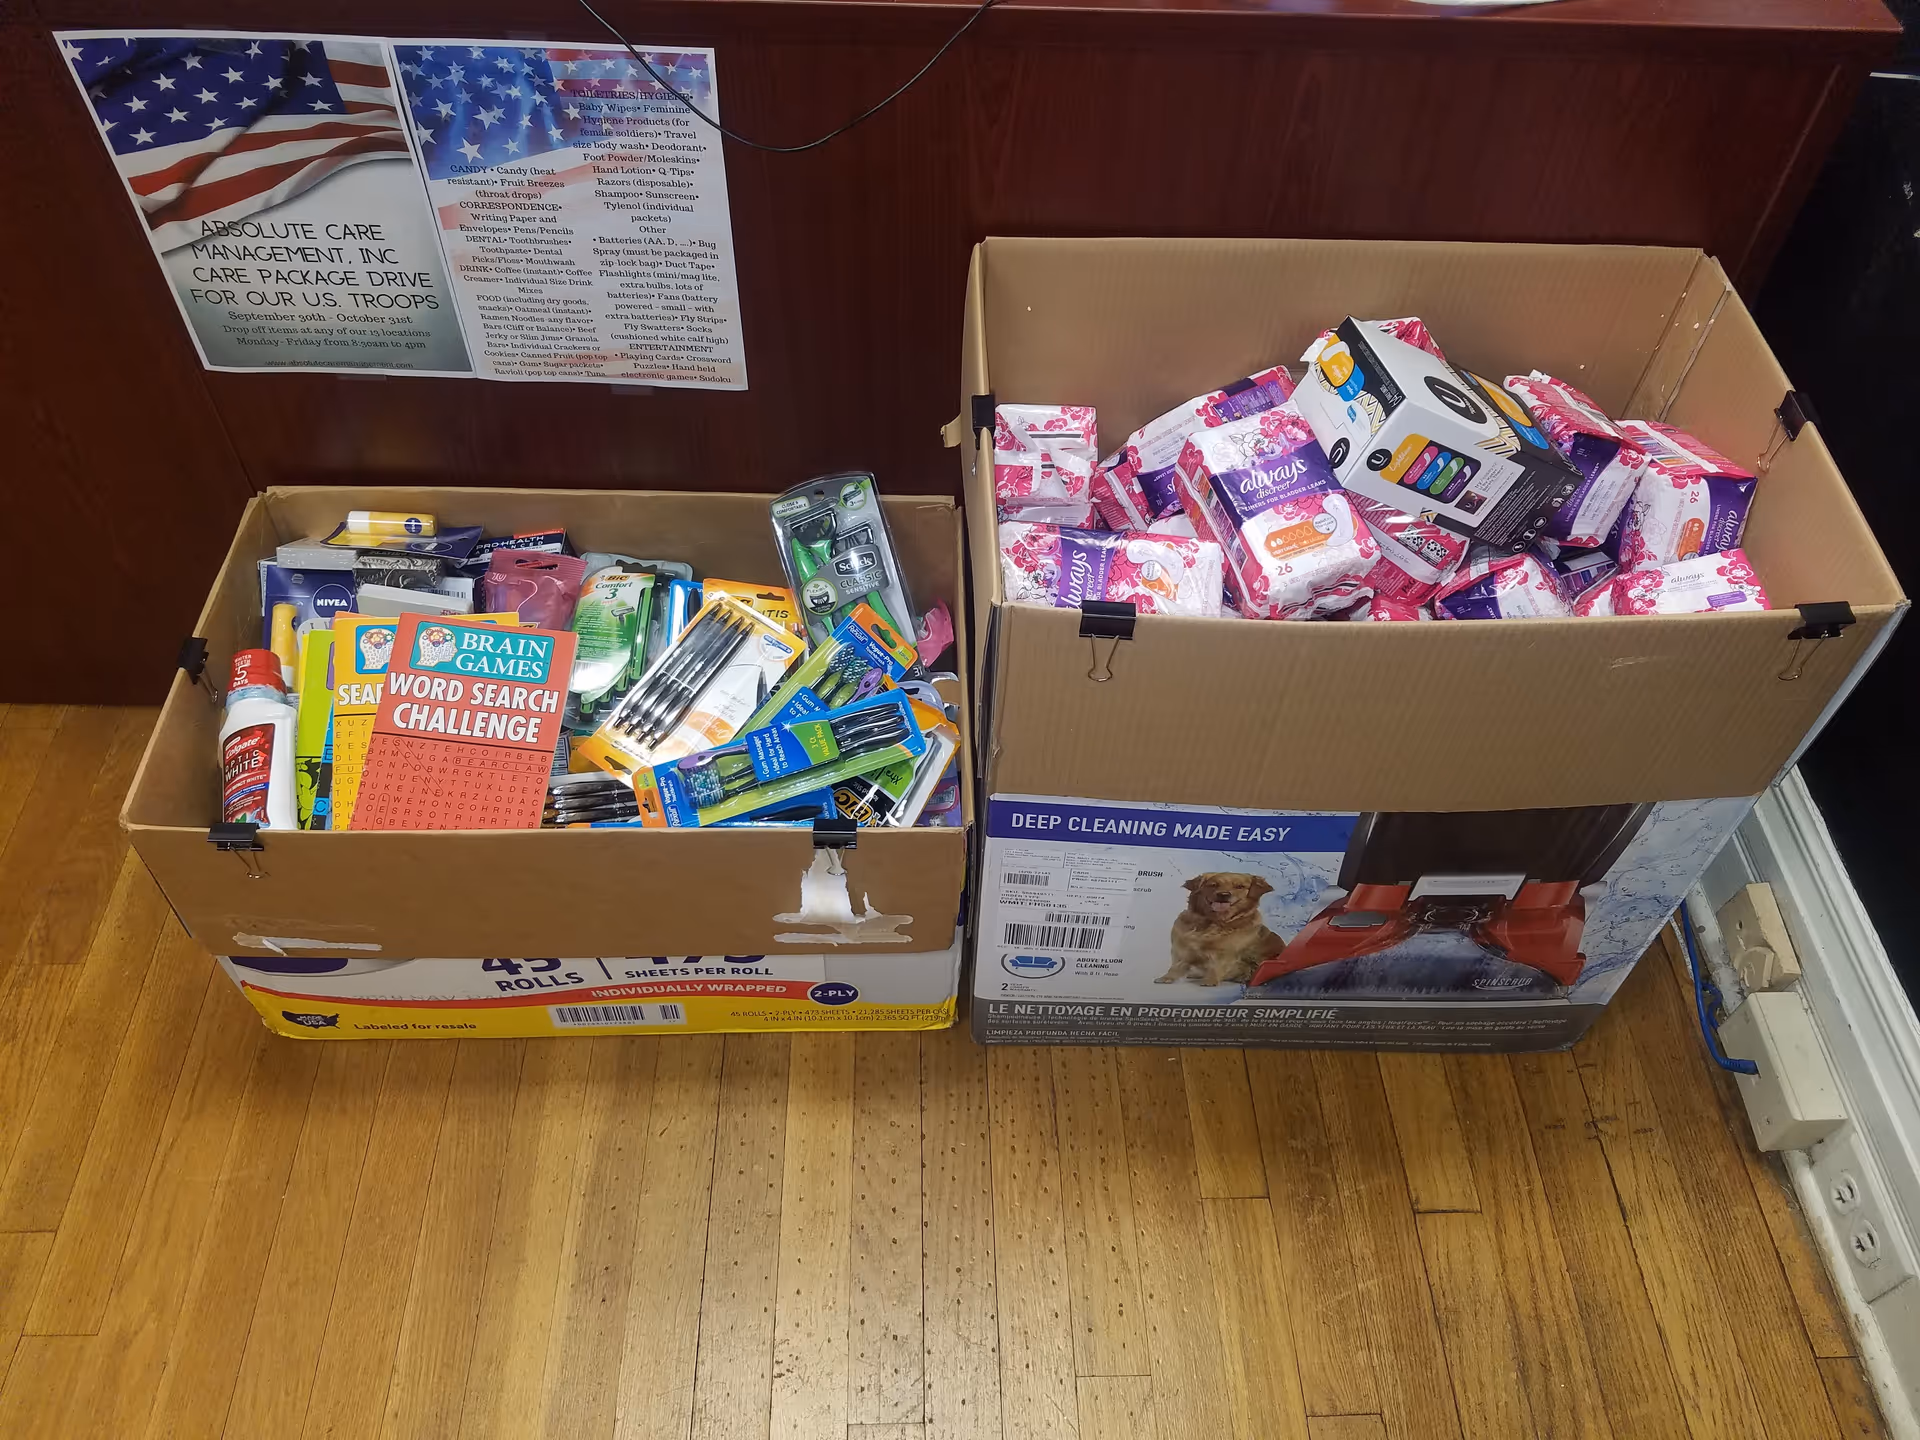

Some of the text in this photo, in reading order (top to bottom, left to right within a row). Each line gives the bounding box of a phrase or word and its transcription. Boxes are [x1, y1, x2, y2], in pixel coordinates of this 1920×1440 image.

[583, 116, 670, 126] Hygiene Products
[580, 128, 696, 139] female Travel
[594, 142, 617, 150] body
[450, 165, 556, 176] CANDY Candy (heat
[501, 179, 564, 188] Fruit Breezes
[597, 178, 630, 186] Razors
[475, 190, 542, 200] (throat drops)
[604, 202, 694, 212] Tylenol (individual
[470, 213, 507, 223] Writing
[509, 215, 536, 223] Paper
[631, 215, 672, 223] packets)
[201, 220, 385, 241] ABSOLUTE CARE
[514, 226, 574, 235] Pens/Pencils
[698, 240, 716, 249] Bug
[362, 248, 399, 264] INC
[593, 248, 708, 259] Spray packaged
[193, 267, 433, 287] CARE PACKAGE DRIVE
[495, 267, 522, 275] Coffee
[599, 270, 700, 281] Flashlights (mini/mag
[505, 275, 548, 285] Individual
[190, 289, 439, 309] FOR OUR U.S. TROOPS
[503, 295, 545, 304] (including
[228, 311, 412, 324] September 30th October 31st
[223, 325, 250, 335] Drop
[252, 325, 267, 334] off
[268, 327, 298, 335] items
[314, 329, 334, 337] any
[369, 330, 379, 338] 13
[381, 329, 430, 337] locations
[286, 337, 322, 348] Friday
[323, 338, 349, 347] from
[351, 339, 388, 348] 8:30am
[391, 340, 401, 348] to
[404, 341, 426, 349] 4pm
[629, 344, 713, 352] ENTERTAINMENT
[1240, 459, 1308, 494] always
[1246, 501, 1266, 511] LINERS
[1280, 488, 1307, 499] BLADDER
[1308, 479, 1326, 489] LEAKS
[1256, 481, 1291, 499] discreet
[1690, 491, 1699, 503] 26
[1278, 563, 1292, 575] 26
[840, 571, 881, 588] CLASSIC
[1097, 565, 1105, 591] BLADDER
[1671, 572, 1704, 584] always
[605, 589, 618, 599] 3
[846, 582, 879, 594] SENSITIVE
[460, 632, 548, 658] BRAIN
[869, 642, 894, 666] Vogue-Pro
[455, 653, 544, 679] GAMES
[235, 665, 247, 681] 5
[233, 679, 248, 687] DAYS
[389, 672, 559, 713] WORD SEARCH
[801, 694, 814, 707] Gum
[794, 702, 808, 715] Ideal
[393, 702, 541, 743] CHALLENGE
[763, 733, 772, 747] Hard
[771, 728, 780, 743] Areas
[814, 724, 830, 756] VALUE PACK
[226, 736, 260, 760] Colgate
[776, 743, 786, 761] Reach
[225, 750, 260, 772] OPTIC
[753, 736, 769, 775] Gum Massager
[225, 759, 262, 782] WHITE
[771, 757, 780, 771] Ideal
[886, 769, 903, 785] Xtra
[660, 776, 670, 804] Vogue-Pro
[1012, 813, 1290, 842] DEEP CLEANING MADE EASY
[625, 967, 773, 979] SHEETS PER ROLL
[496, 972, 584, 991] ROLLS
[592, 984, 787, 998] INDIVIDUALLY WRAPPED
[814, 989, 854, 998] 2-PLY
[989, 1004, 1008, 1014] LE
[1015, 1005, 1105, 1015] NETTOYAGE
[1111, 1007, 1132, 1016] EN
[1138, 1008, 1248, 1018] PROFONDEUR
[1254, 1008, 1338, 1019] SIMPLIFIÉ
